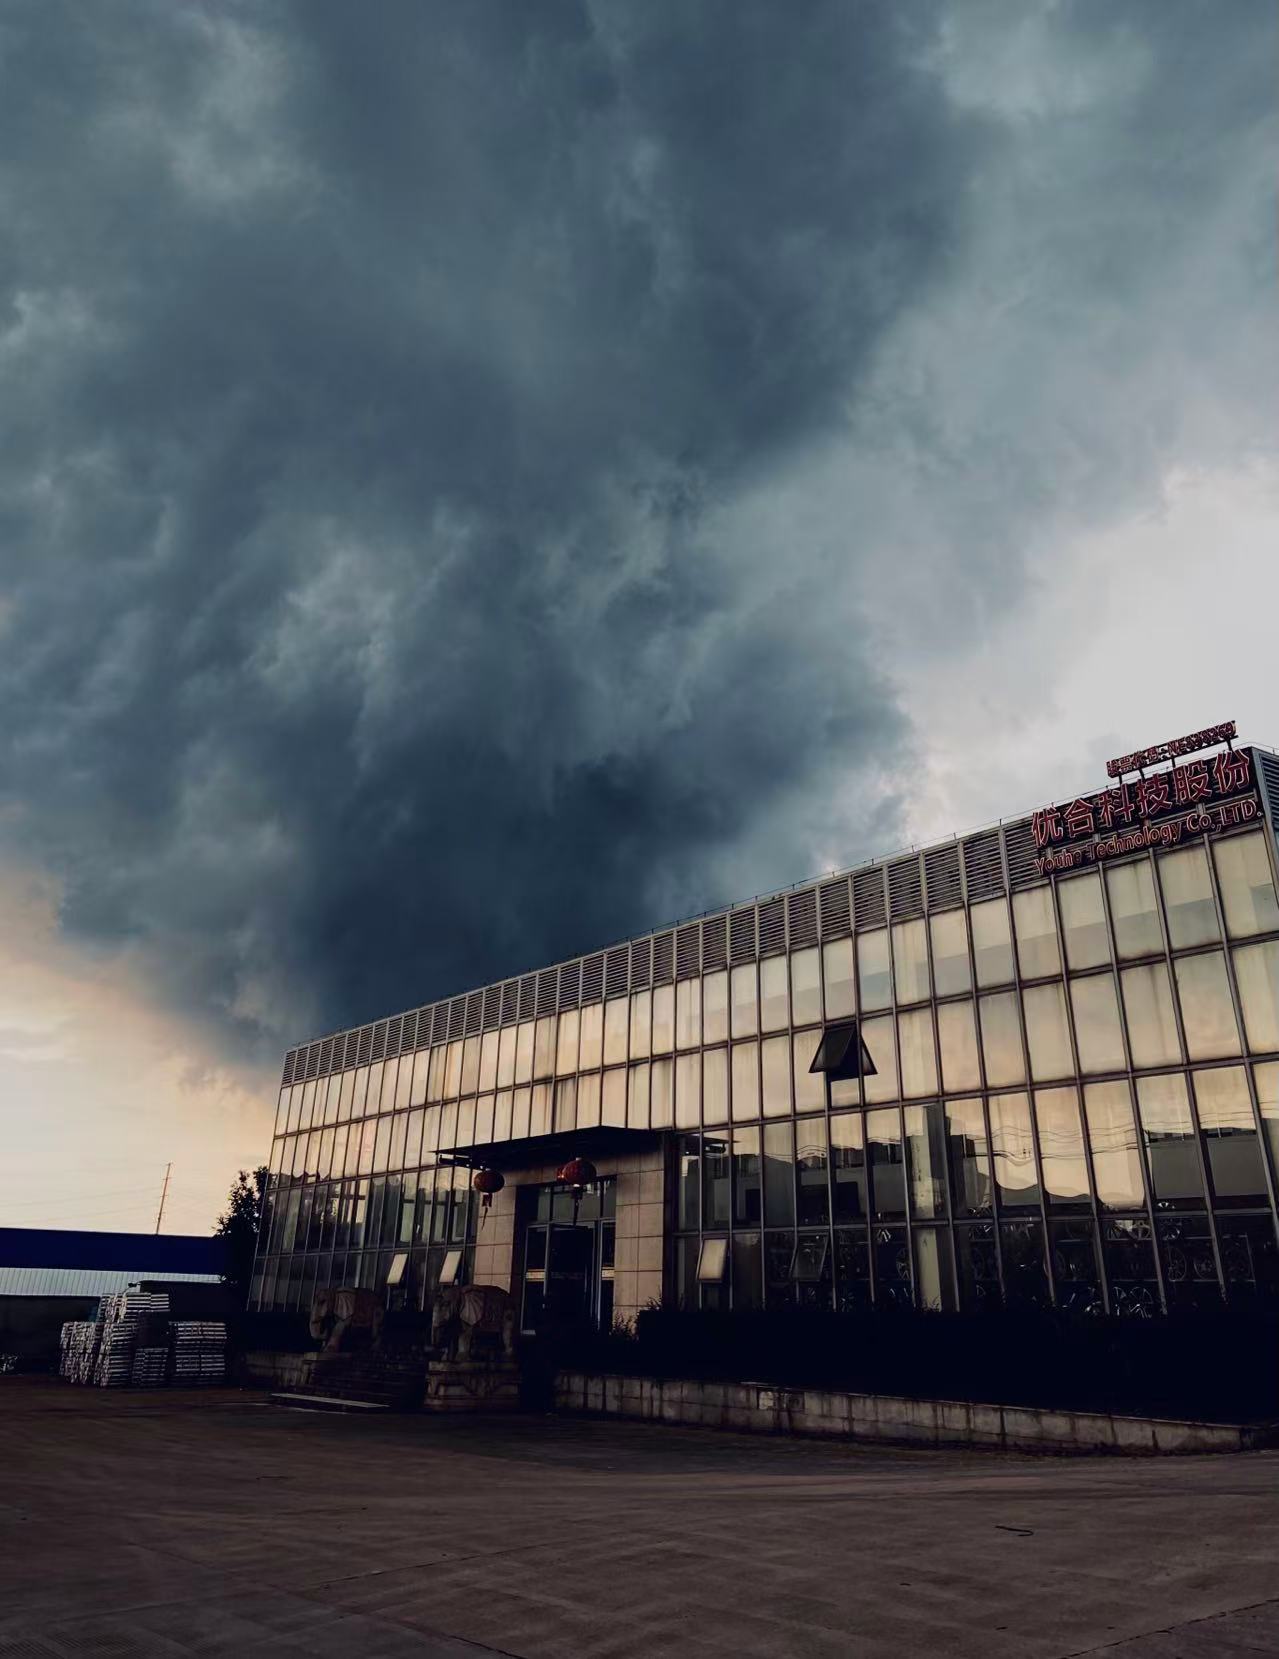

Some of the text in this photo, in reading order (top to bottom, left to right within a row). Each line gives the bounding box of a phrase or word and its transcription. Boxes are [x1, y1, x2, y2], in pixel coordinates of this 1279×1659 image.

[1031, 749, 1250, 849] 优合科技股份
[1034, 847, 1082, 875] Youhe
[1089, 820, 1182, 860] Technology
